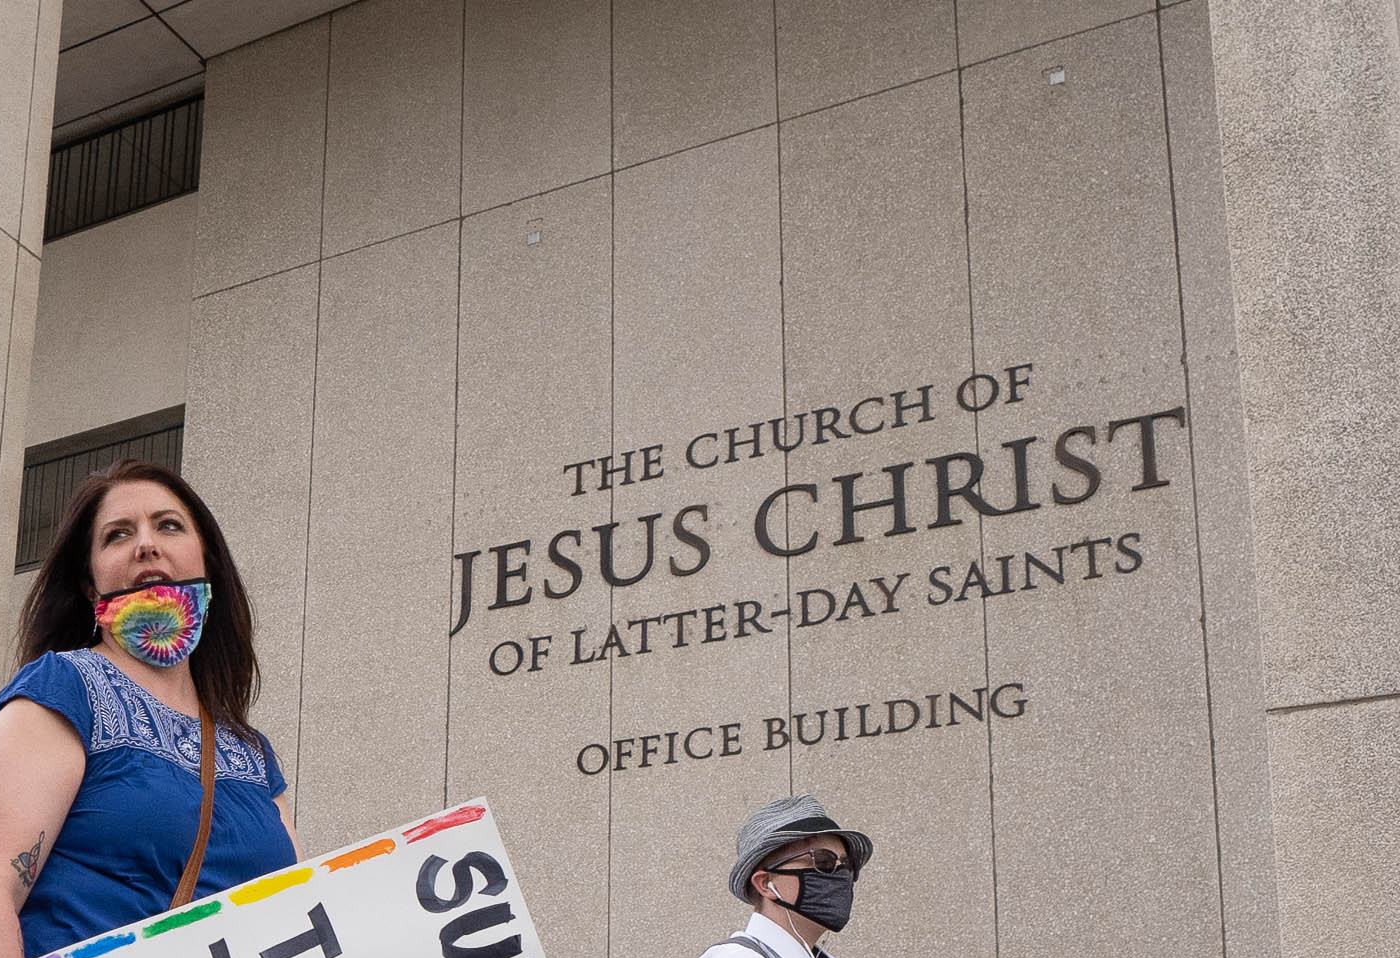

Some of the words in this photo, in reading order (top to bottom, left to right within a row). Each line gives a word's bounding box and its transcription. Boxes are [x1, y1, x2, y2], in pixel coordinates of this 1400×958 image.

[564, 444, 664, 497] THE
[686, 384, 934, 469] CHURCH
[956, 364, 1034, 412] OF
[449, 504, 712, 637] JESUS
[753, 406, 1185, 557] CHRIST
[488, 635, 553, 676] OF
[570, 574, 910, 665] LATTER-DAY
[927, 532, 1144, 606] SAINTS
[576, 722, 742, 776] OFFICE
[763, 683, 1028, 750] BUILDING
